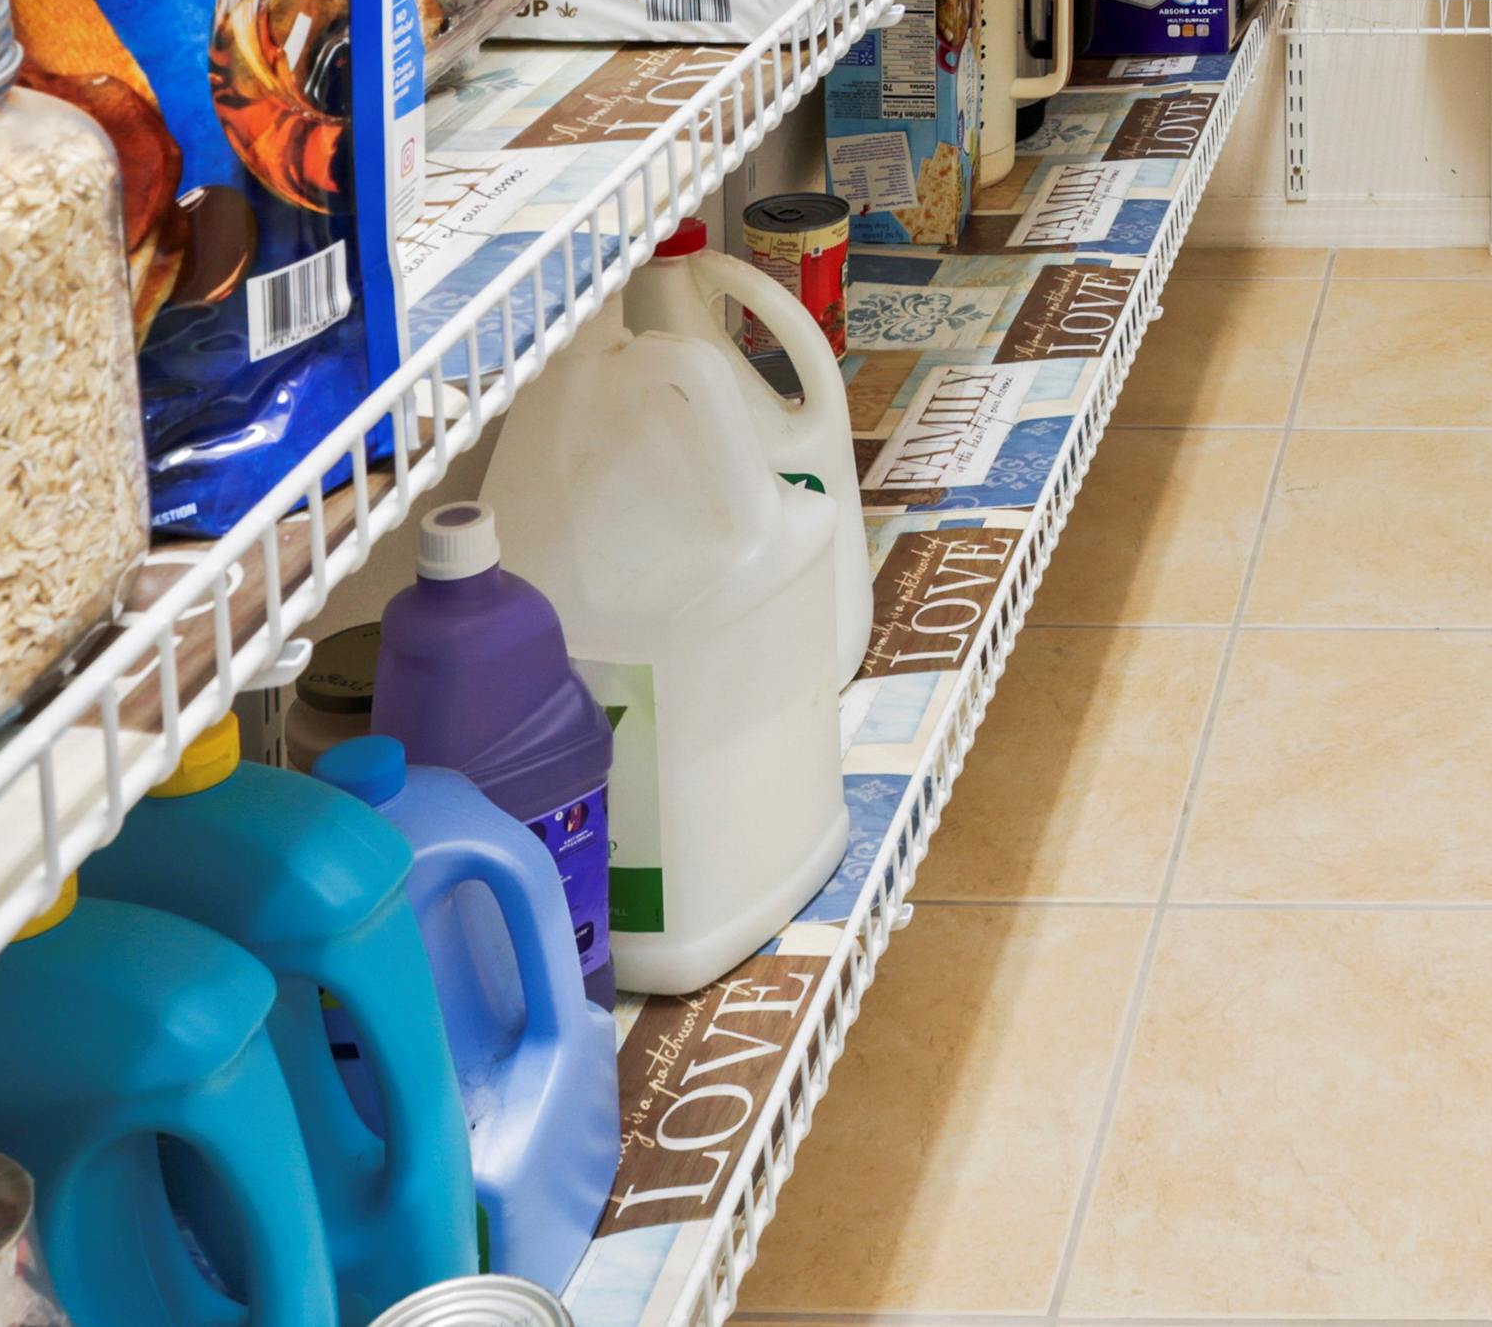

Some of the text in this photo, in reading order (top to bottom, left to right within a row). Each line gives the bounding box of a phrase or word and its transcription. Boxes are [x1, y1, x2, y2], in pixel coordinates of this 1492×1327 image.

[883, 111, 936, 119] Nutrition Facts
[1146, 96, 1213, 158] LOVE
[1022, 165, 1107, 245] FAMILY
[1045, 271, 1139, 356] LOVE
[880, 368, 999, 488] FAMILY
[890, 537, 1014, 668] LOVE
[614, 972, 815, 1219] LOVE
